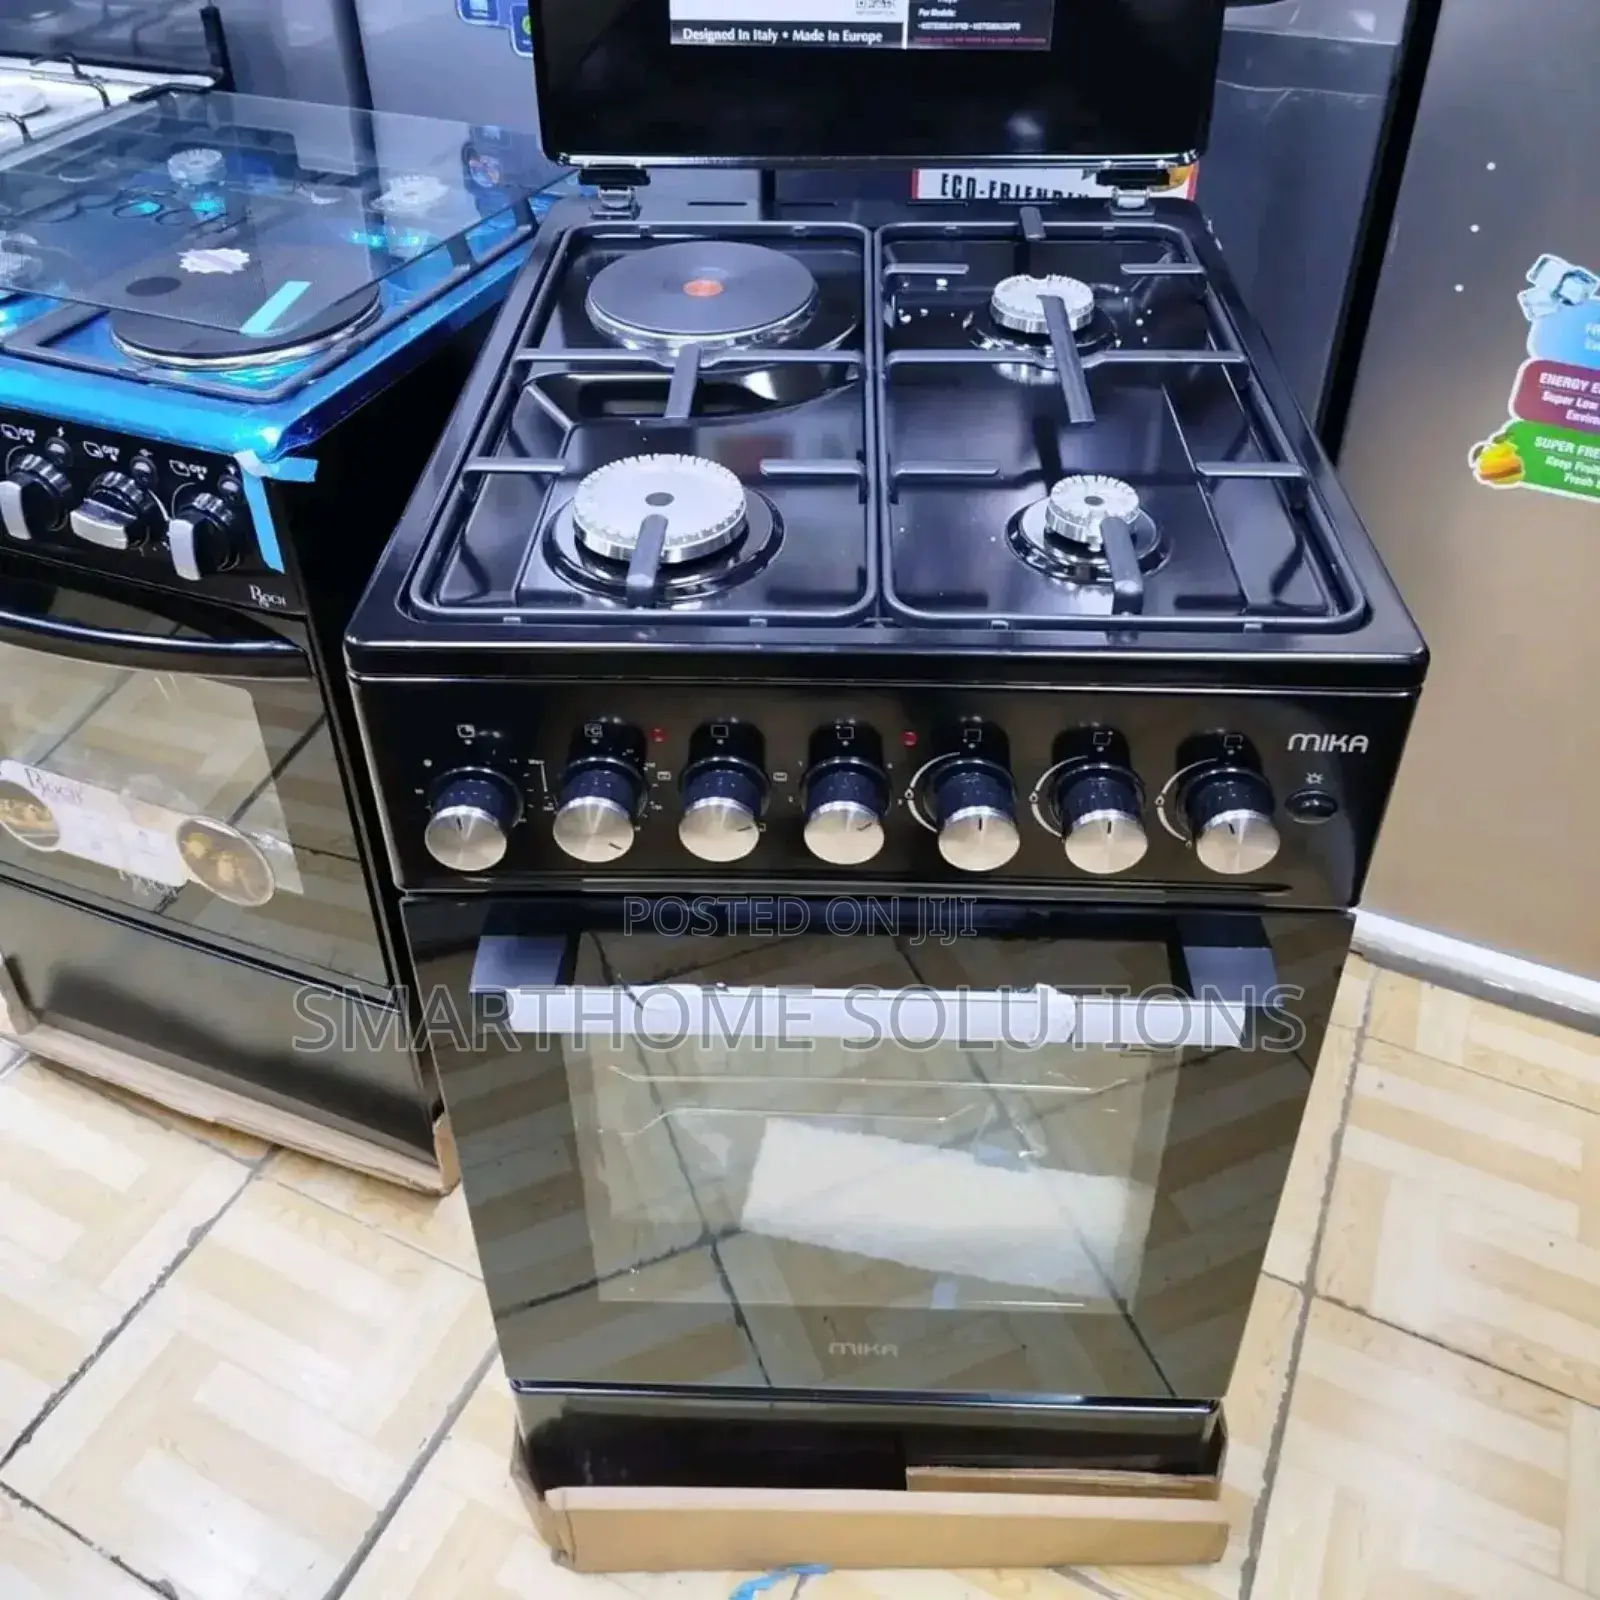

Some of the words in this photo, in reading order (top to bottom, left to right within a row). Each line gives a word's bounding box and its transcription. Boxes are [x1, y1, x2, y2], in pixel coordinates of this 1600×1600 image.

[682, 27, 735, 43] Designed
[752, 30, 778, 44] Italy
[792, 30, 825, 42] Made
[842, 31, 884, 46] Europe
[1538, 371, 1590, 392] ENERGY
[1590, 381, 1600, 395] E
[1541, 389, 1575, 406] Super
[1576, 396, 1599, 410] Low
[18, 427, 36, 438] OFF
[102, 445, 120, 456] OFF
[1534, 435, 1577, 454] SUPER
[189, 463, 208, 475] OFF
[1545, 455, 1573, 471] Keep
[1563, 471, 1594, 488] Fresh
[1287, 733, 1369, 754] MIKA
[828, 1342, 899, 1357] MIKA
